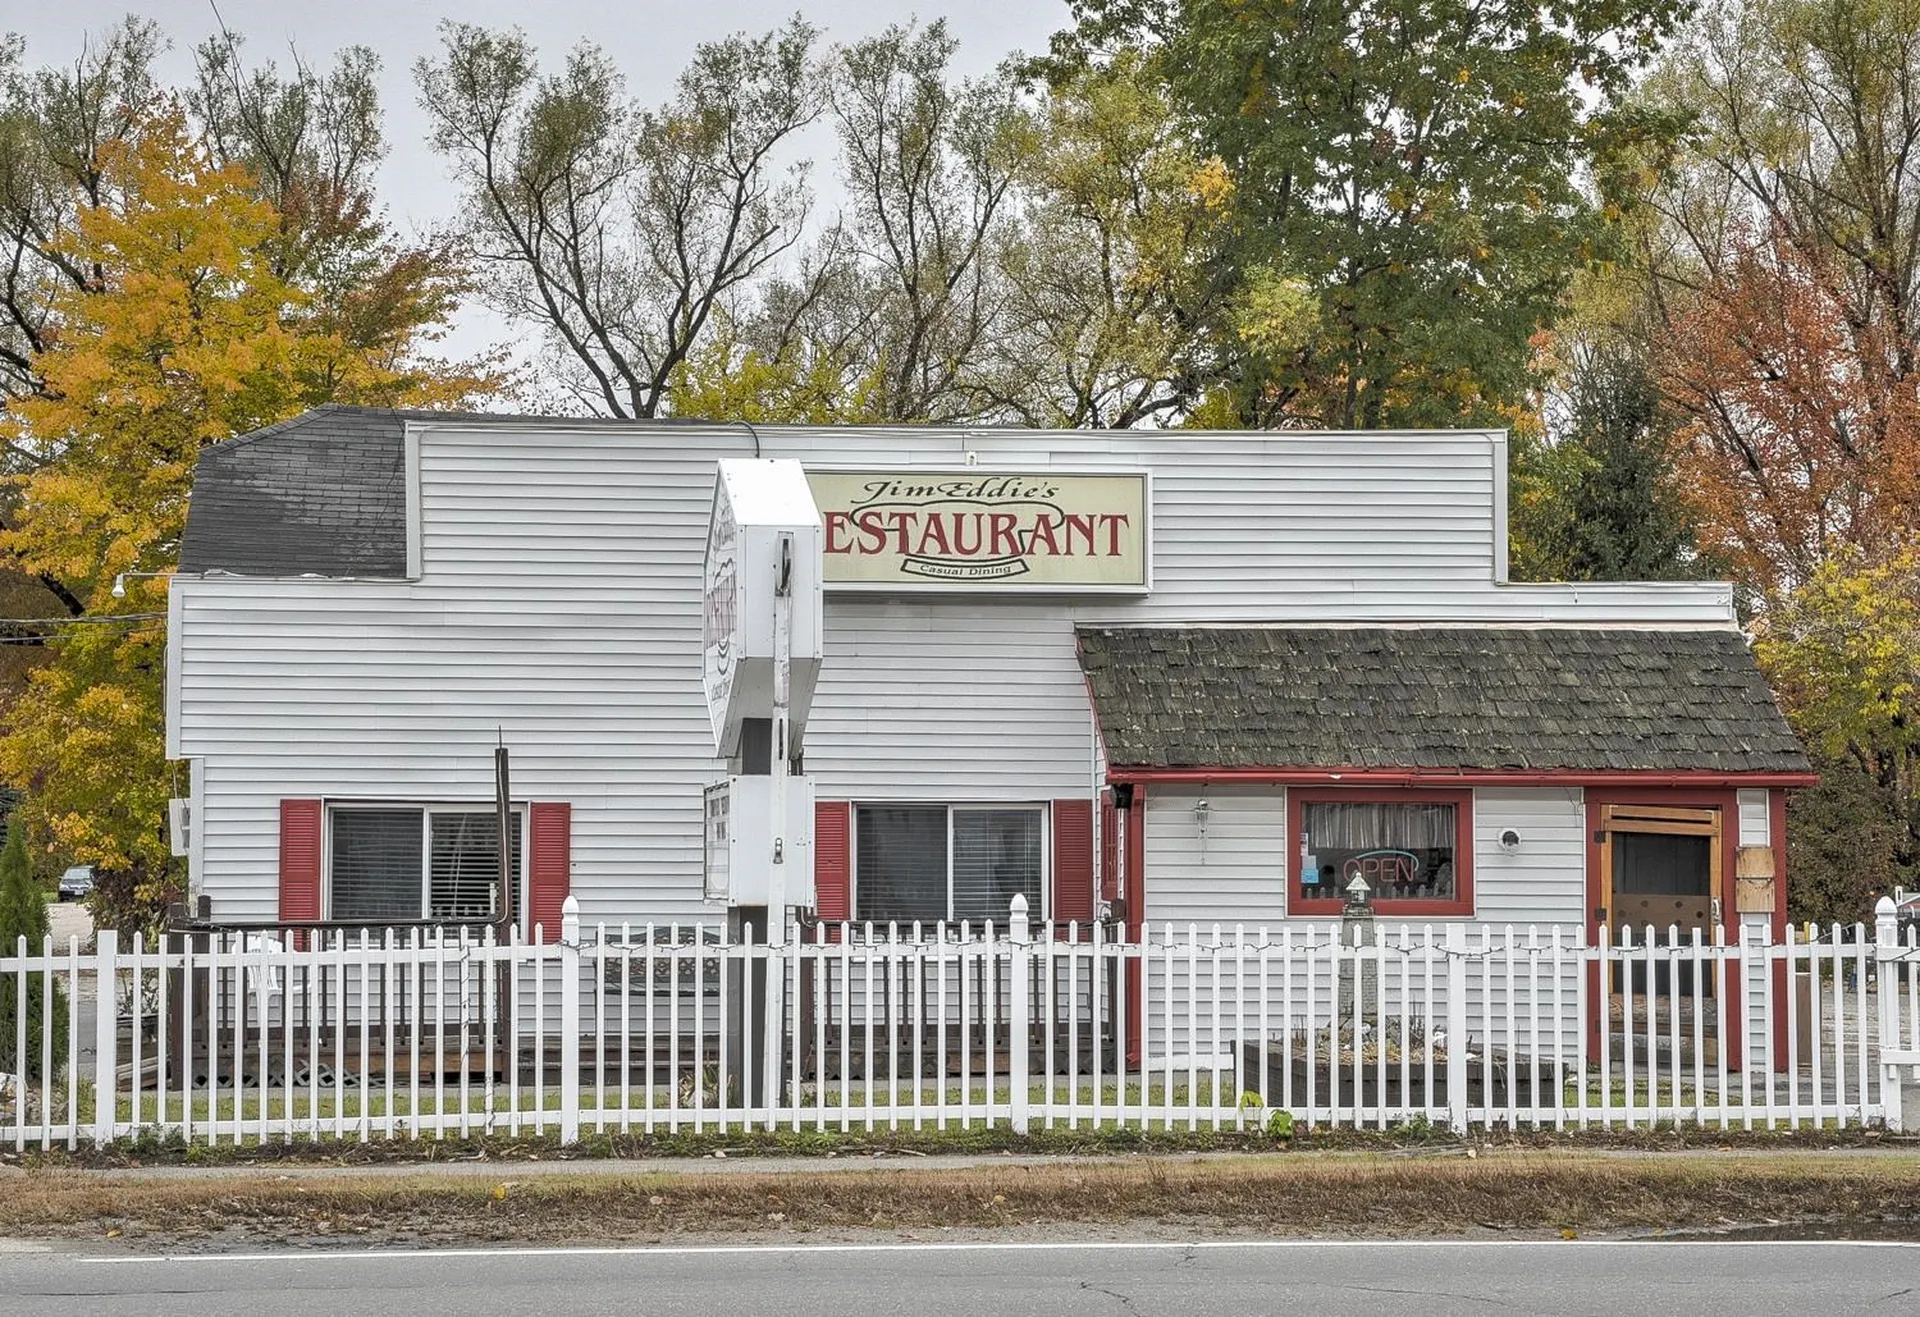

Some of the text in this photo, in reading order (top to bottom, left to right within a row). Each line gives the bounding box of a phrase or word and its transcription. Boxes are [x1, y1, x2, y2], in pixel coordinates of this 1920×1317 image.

[823, 511, 1130, 556] ESTAURANT
[919, 563, 1012, 577] Casual Dining
[1343, 857, 1414, 882] OPEN
